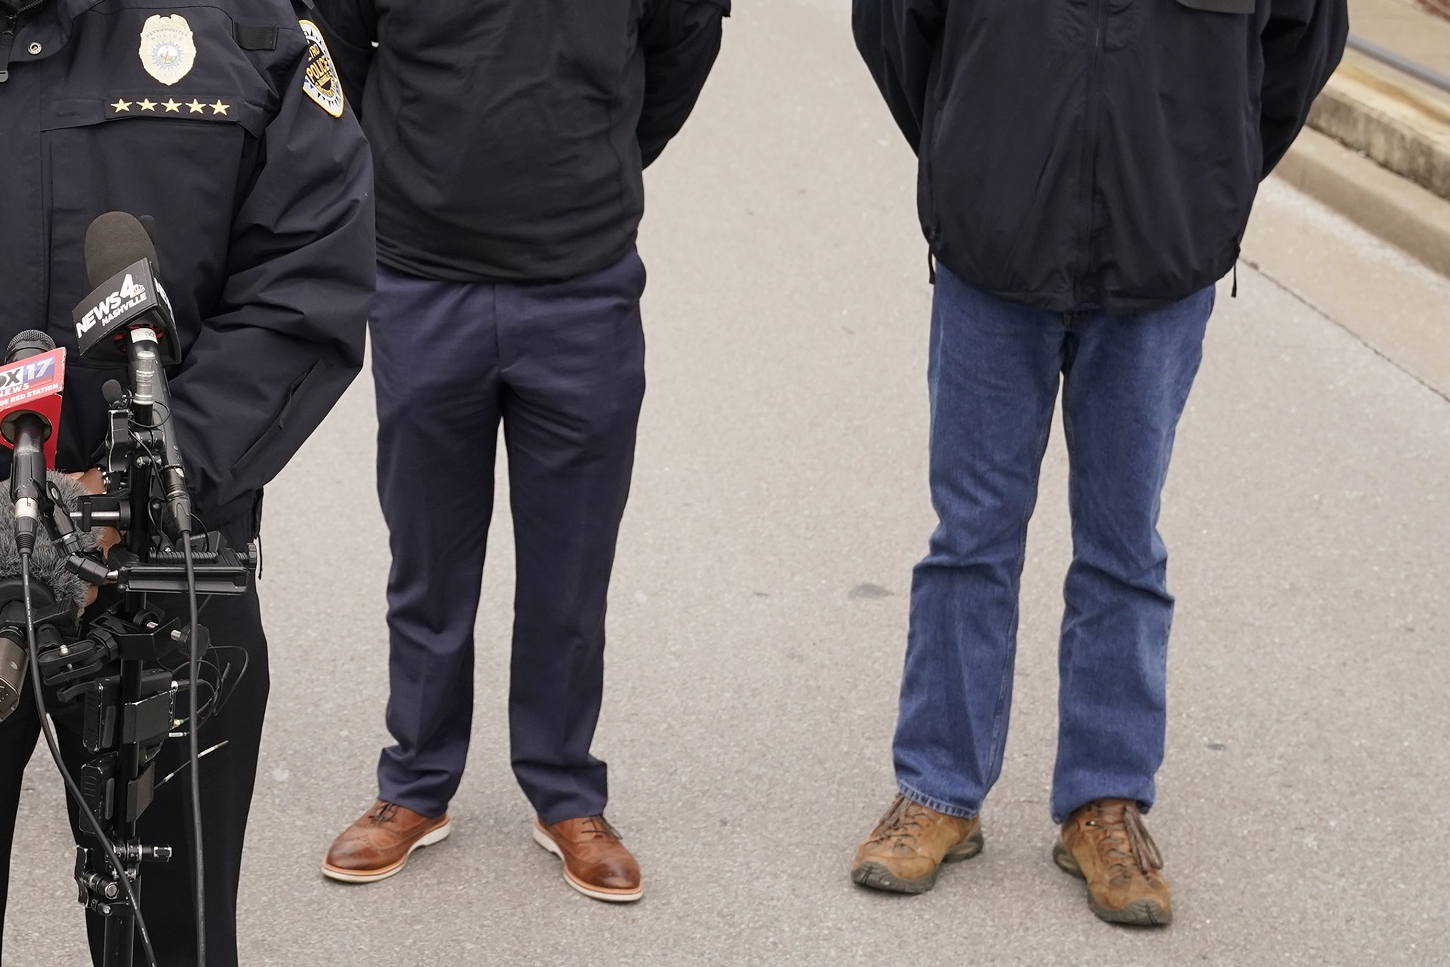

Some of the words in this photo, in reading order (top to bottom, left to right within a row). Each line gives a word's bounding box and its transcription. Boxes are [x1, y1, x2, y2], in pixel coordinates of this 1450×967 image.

[102, 292, 147, 326] NASHVILLE
[25, 358, 52, 380] 17
[10, 393, 25, 403] RED
[26, 383, 59, 397] STATION
